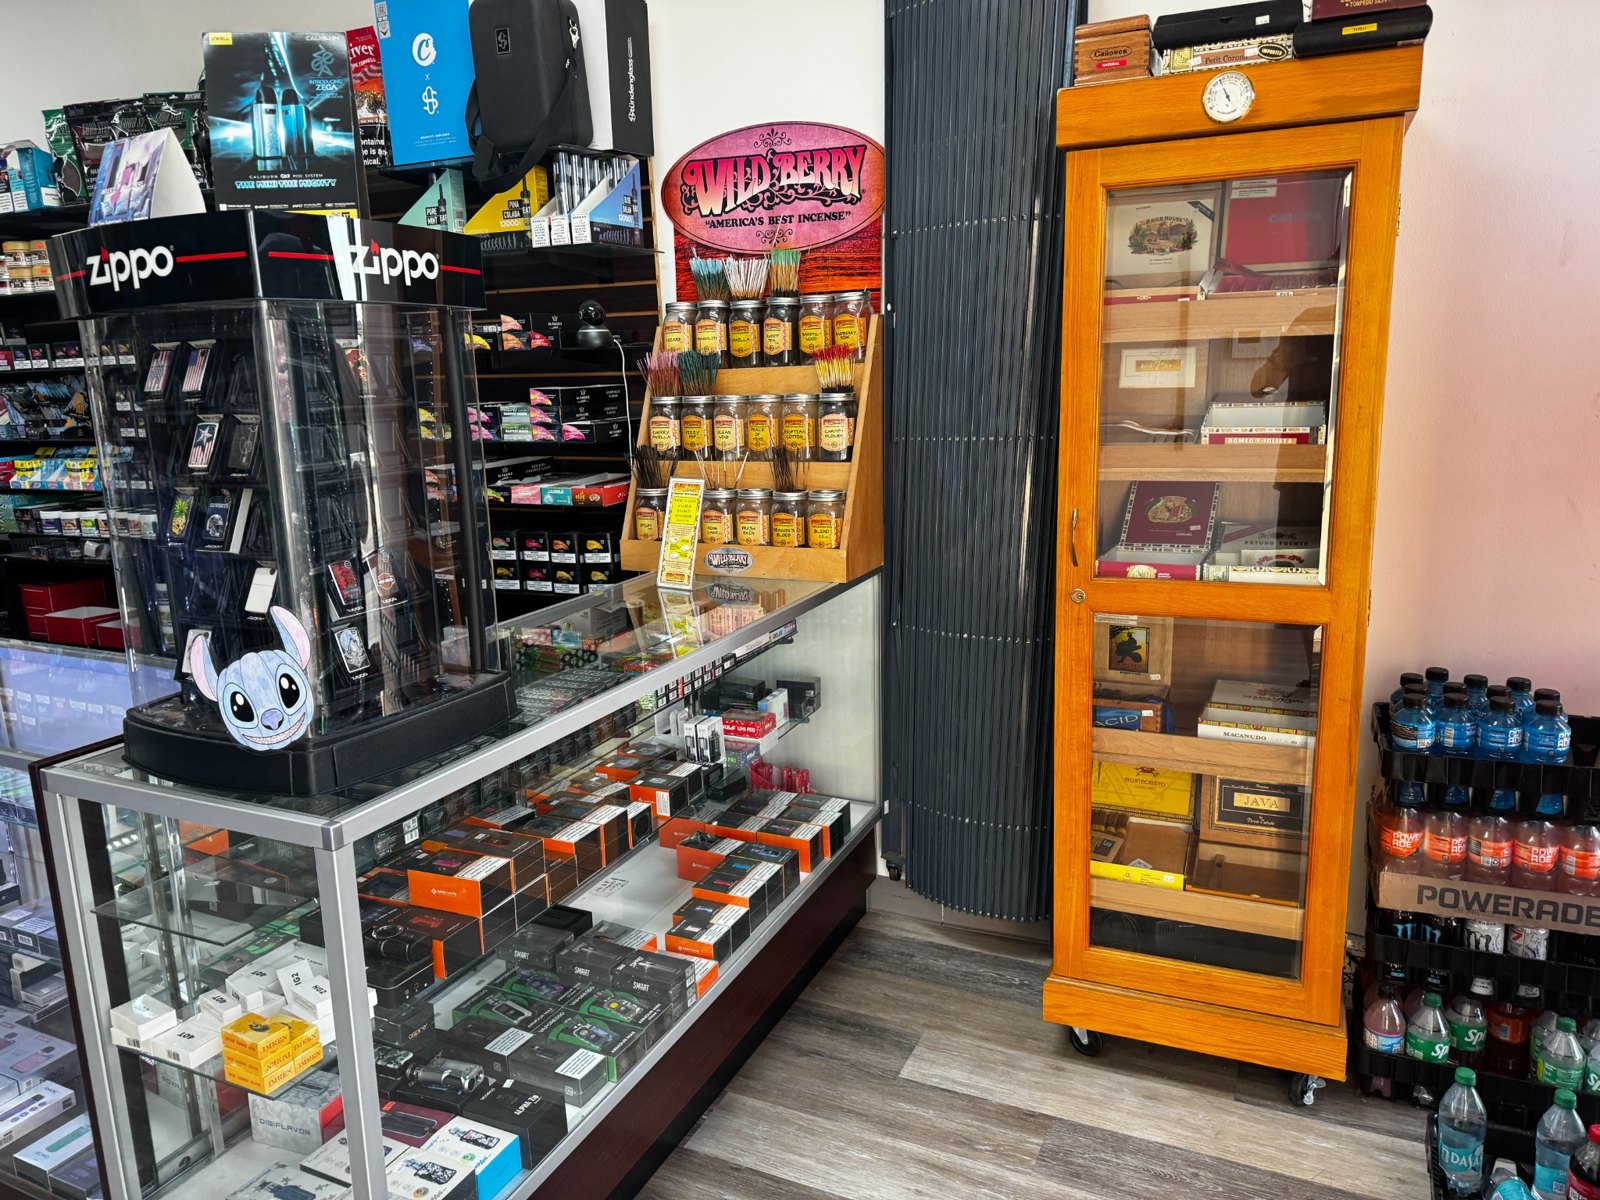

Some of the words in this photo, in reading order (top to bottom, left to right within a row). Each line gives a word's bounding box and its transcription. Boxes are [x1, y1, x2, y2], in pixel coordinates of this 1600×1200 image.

[1205, 56, 1222, 65] Petit
[299, 179, 337, 188] MIGHTY
[682, 153, 772, 218] WILD
[774, 145, 867, 200] BERRY
[768, 214, 794, 225] BEST
[1223, 731, 1267, 741] MACANUDO
[1125, 777, 1166, 787] MONTECRISTO
[1244, 799, 1280, 809] JAVA
[1393, 840, 1412, 848] ADE
[1416, 884, 1600, 928] POWERADE
[514, 950, 529, 960] SMART
[574, 967, 590, 977] SMART
[632, 981, 650, 992] SMART
[262, 1035, 288, 1052] IMREN
[1451, 1152, 1483, 1169] DASA
